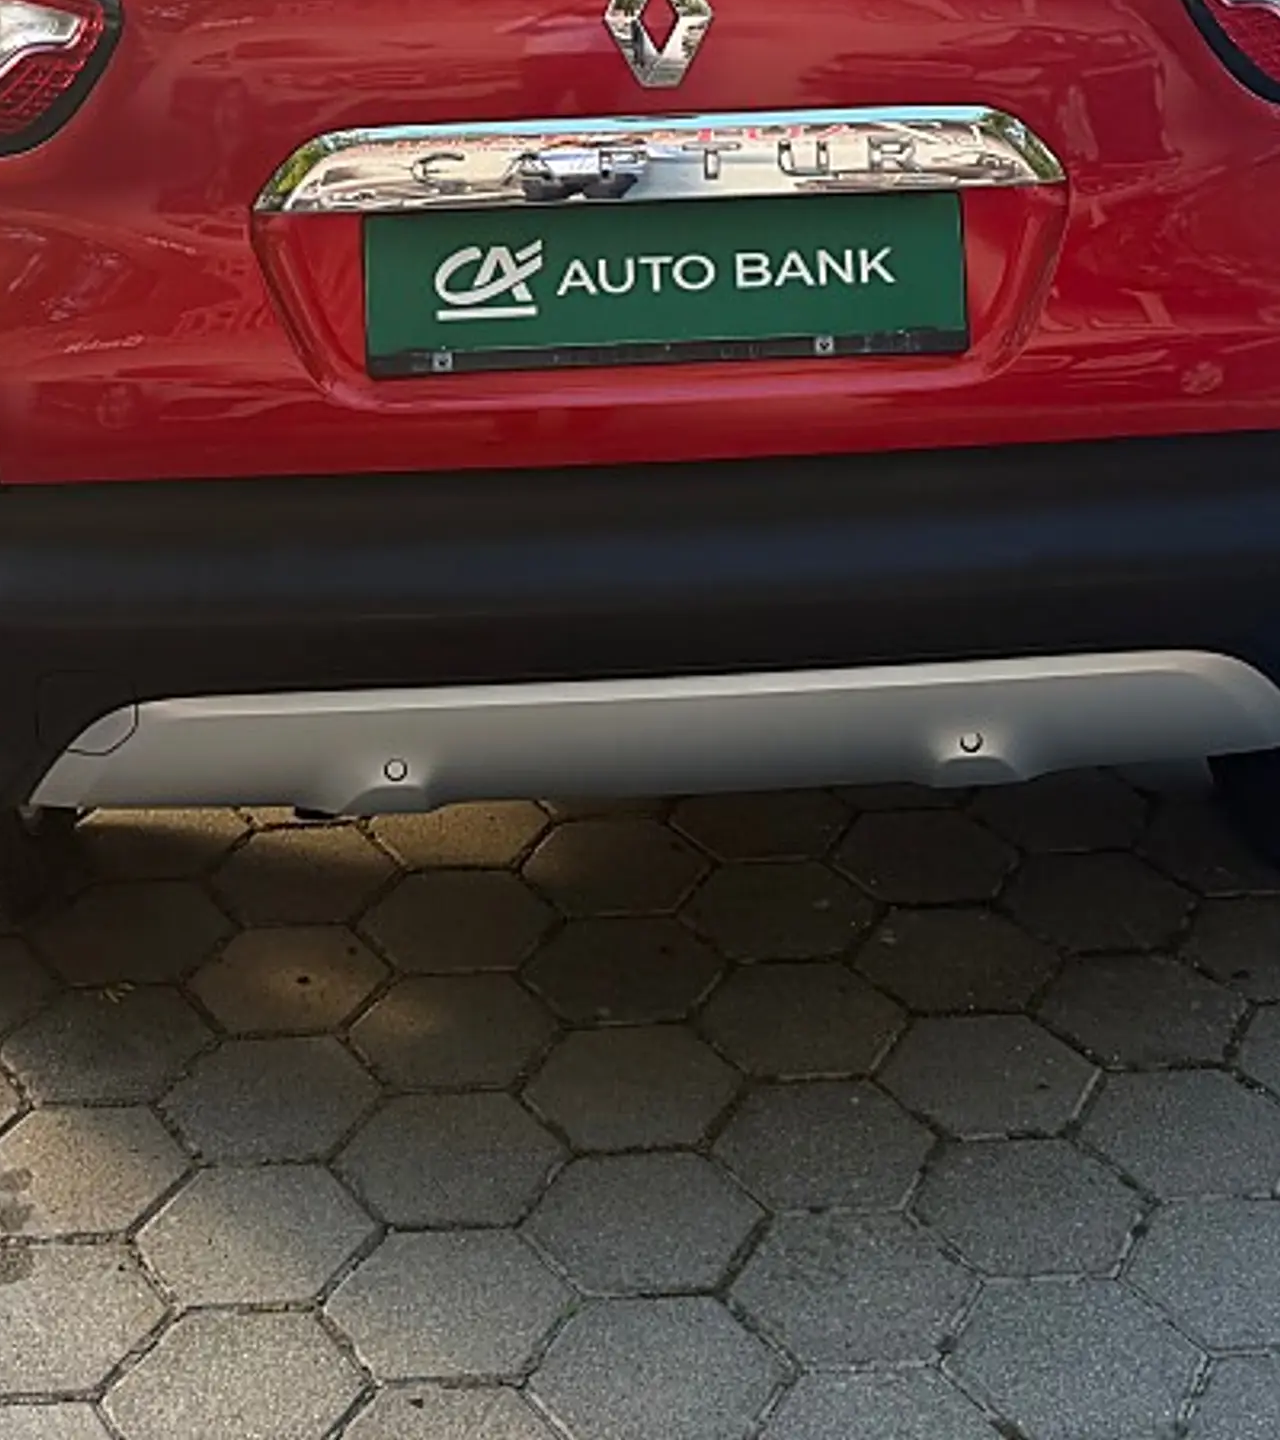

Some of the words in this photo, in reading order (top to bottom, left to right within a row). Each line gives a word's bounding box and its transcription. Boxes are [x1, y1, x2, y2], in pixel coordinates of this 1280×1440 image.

[412, 135, 921, 186] CAPTUR
[557, 254, 717, 298] AUTO
[735, 246, 897, 289] BANK
